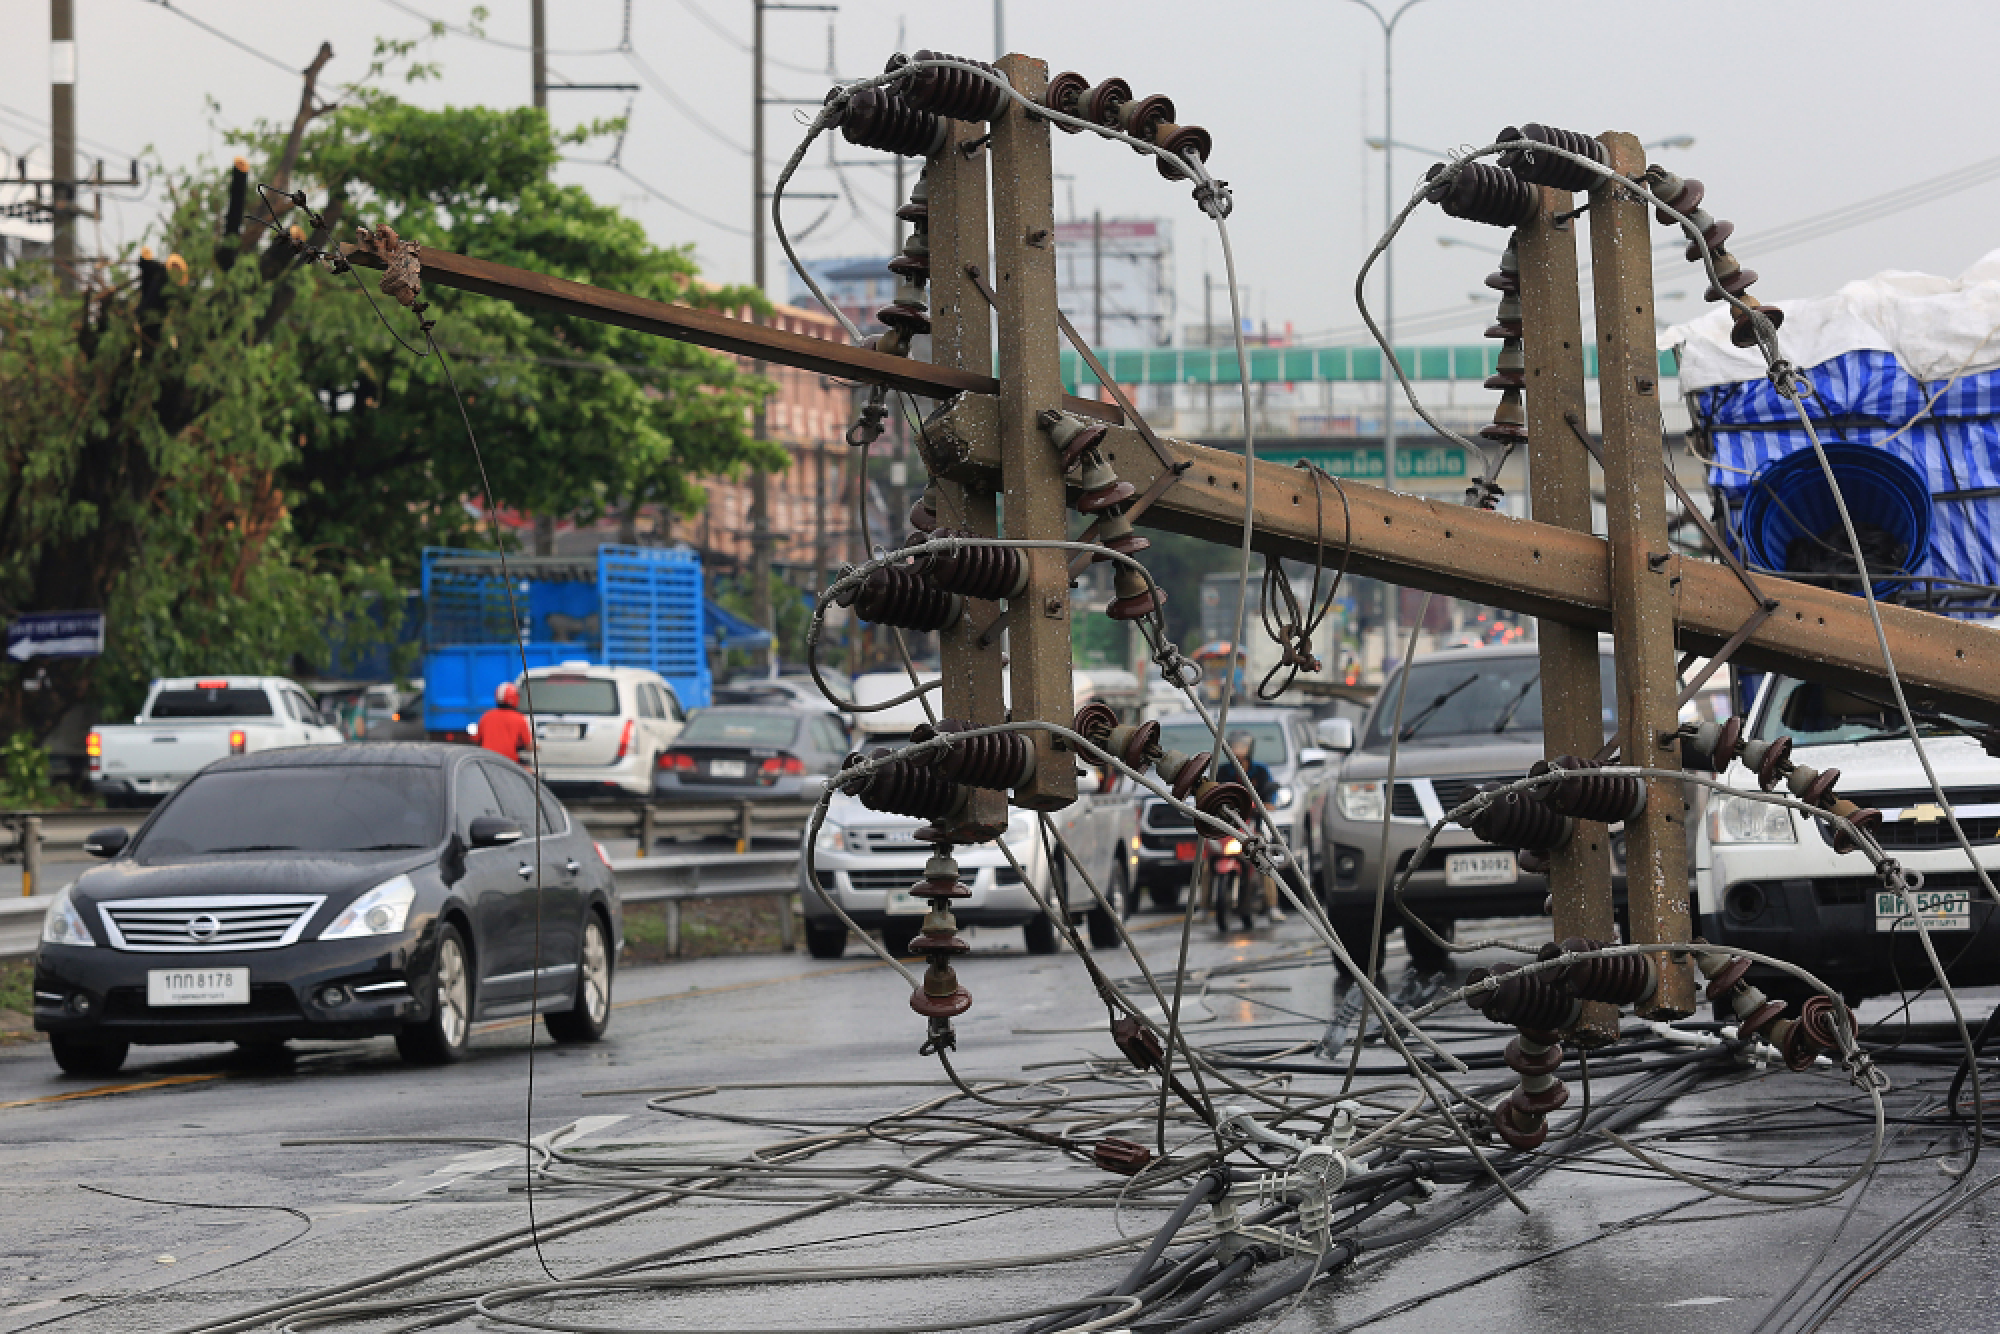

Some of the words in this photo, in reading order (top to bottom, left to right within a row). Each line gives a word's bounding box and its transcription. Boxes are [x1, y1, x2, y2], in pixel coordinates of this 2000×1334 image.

[1918, 893, 1967, 913] 5067
[164, 973, 195, 990] 1กก
[197, 972, 234, 989] 8178
